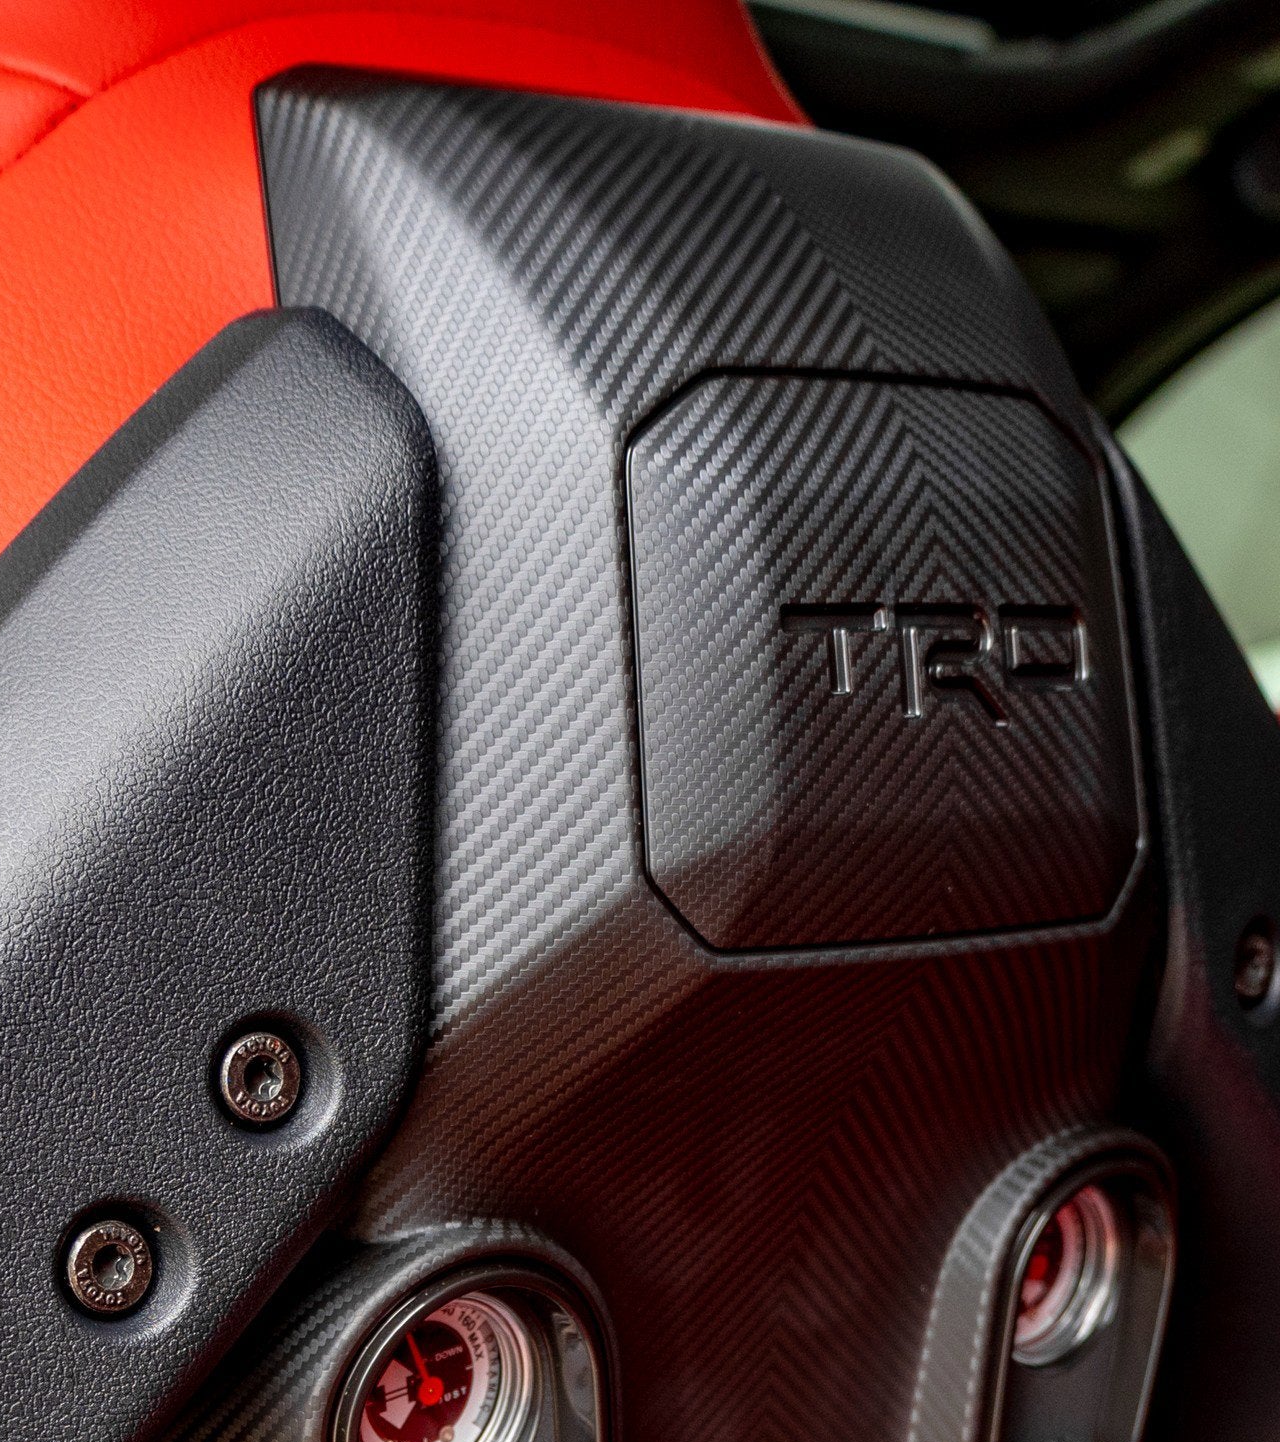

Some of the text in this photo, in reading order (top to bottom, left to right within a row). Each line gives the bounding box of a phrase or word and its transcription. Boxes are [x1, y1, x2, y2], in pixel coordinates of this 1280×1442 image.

[780, 602, 1090, 728] TRD
[435, 1345, 463, 1362] DOWN
[468, 1332, 485, 1361] MAX
